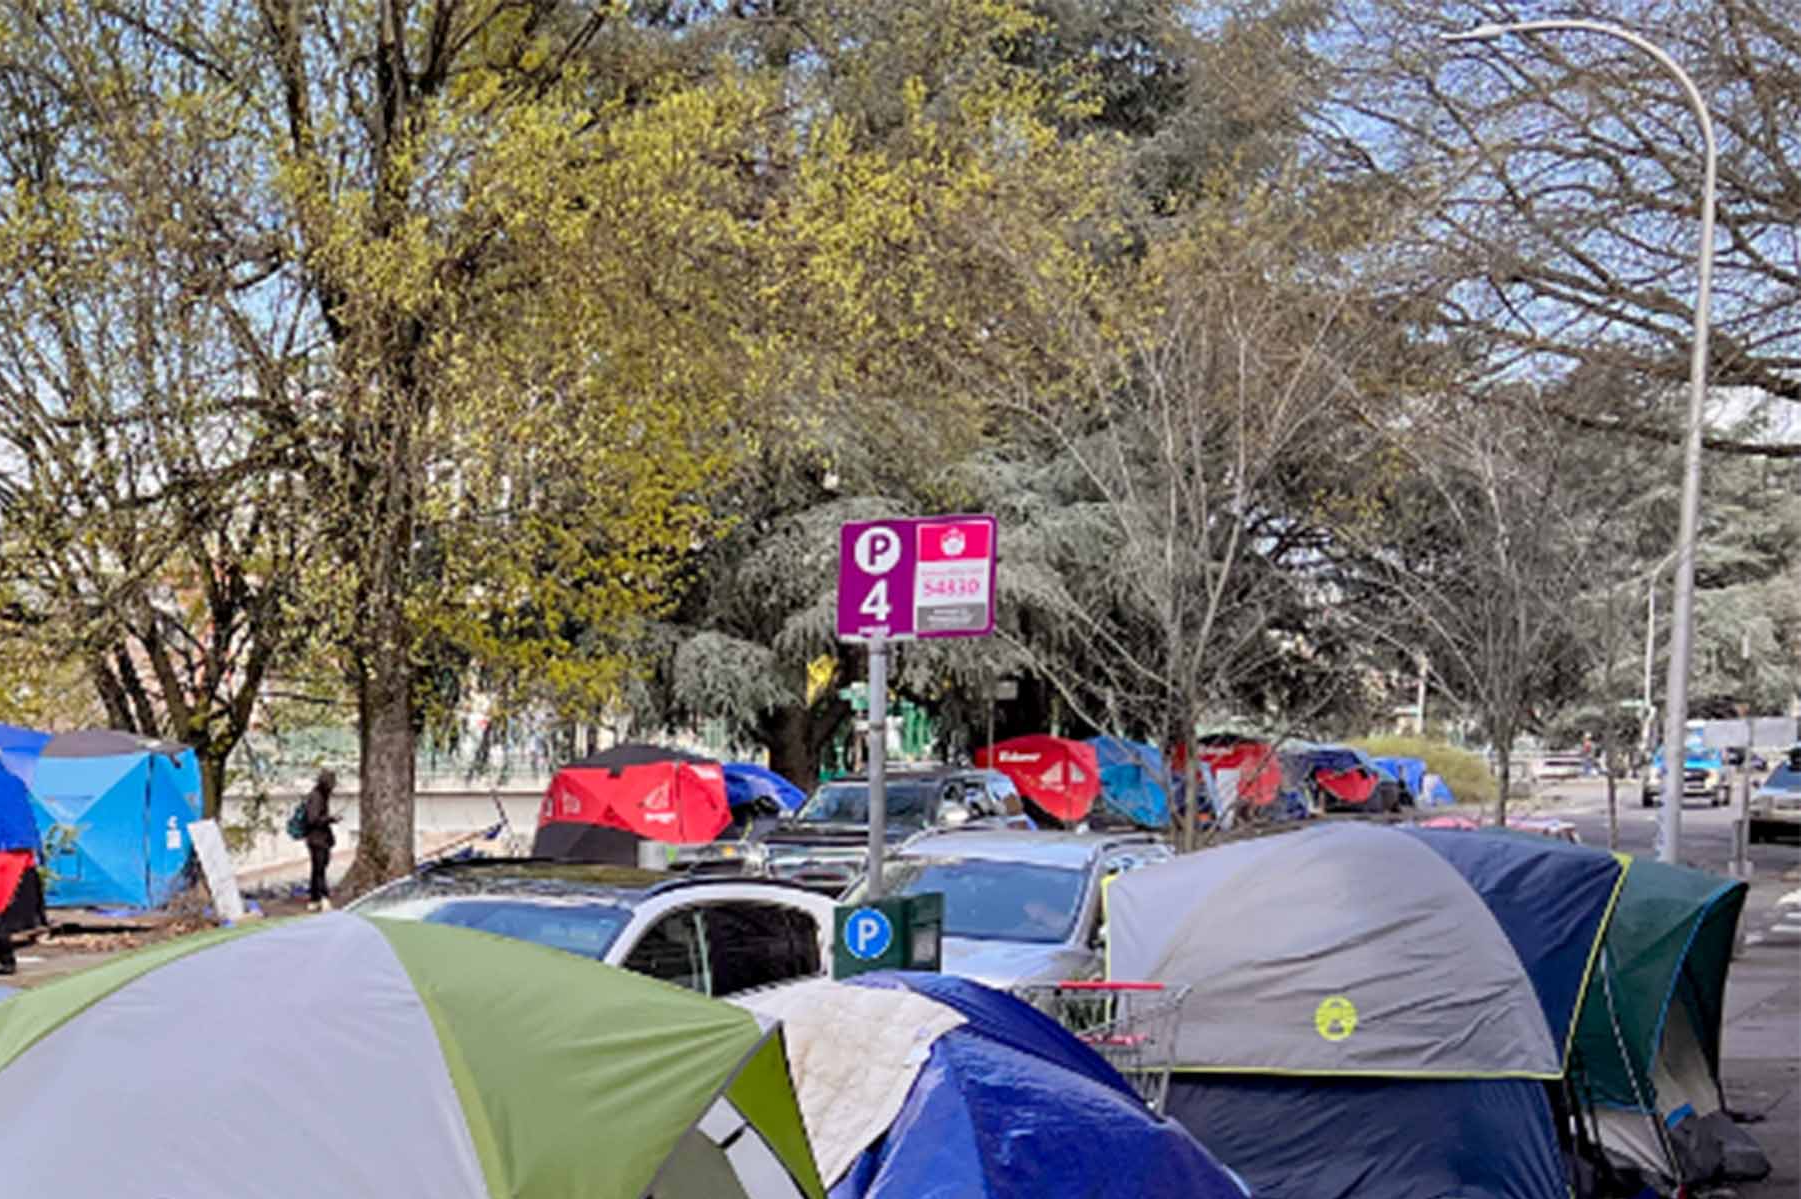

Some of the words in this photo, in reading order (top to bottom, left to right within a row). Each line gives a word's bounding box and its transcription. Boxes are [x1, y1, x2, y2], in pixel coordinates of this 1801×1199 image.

[868, 534, 892, 567] P
[859, 579, 892, 621] 4
[857, 918, 880, 951] P
